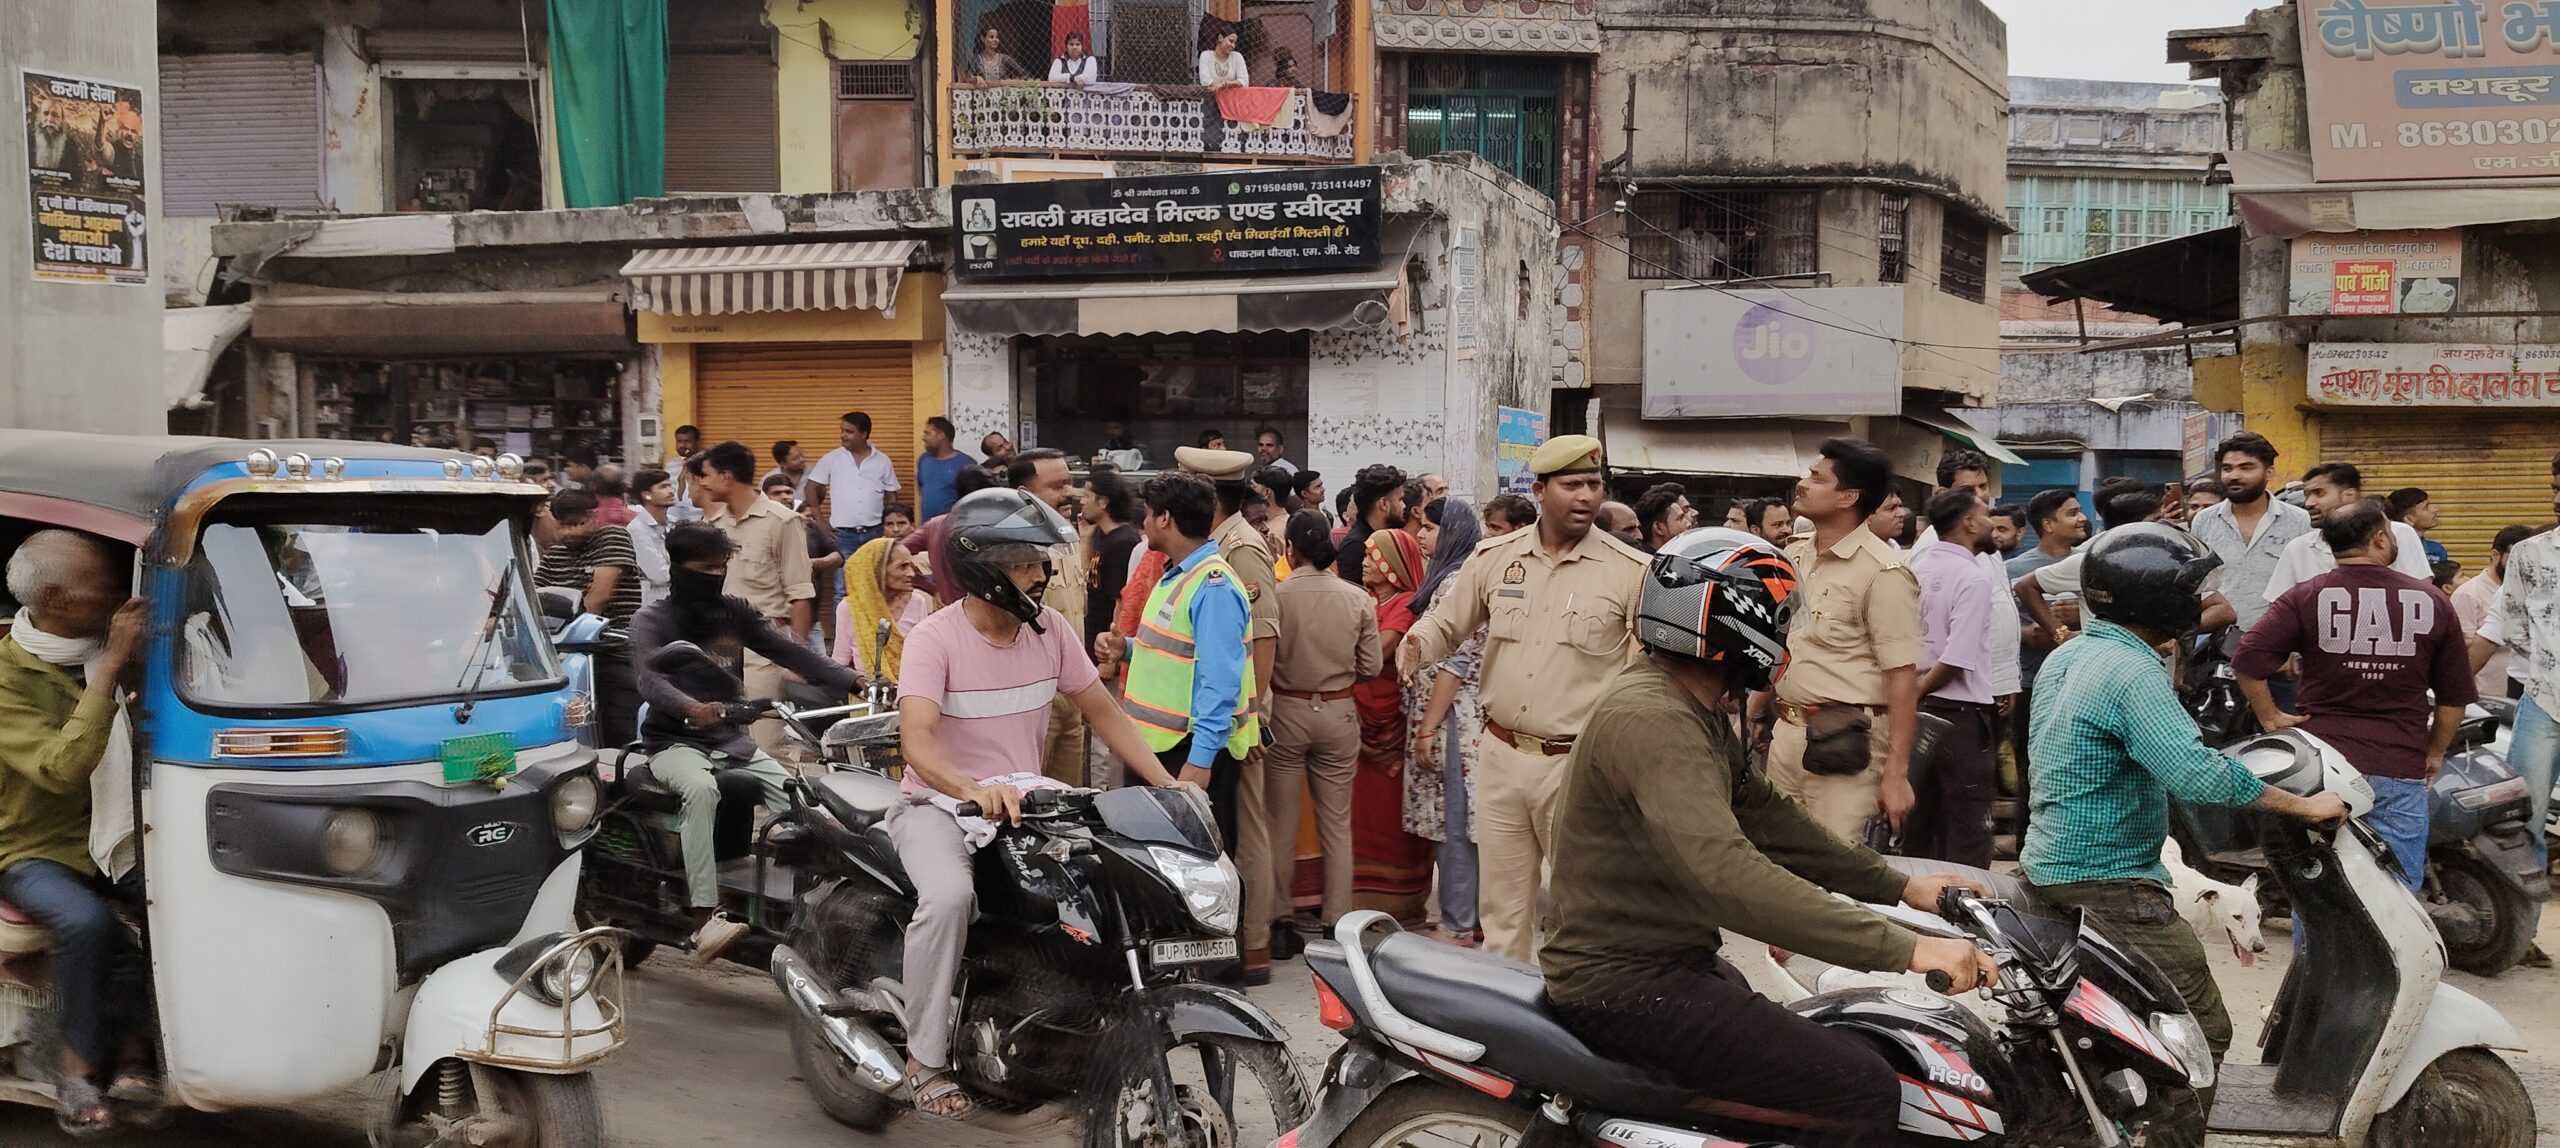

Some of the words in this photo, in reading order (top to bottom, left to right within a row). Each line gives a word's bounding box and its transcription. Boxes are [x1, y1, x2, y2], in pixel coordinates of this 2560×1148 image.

[50, 80, 89, 100] करणी
[91, 83, 116, 103] सेना
[2408, 75, 2555, 102] मशहूर
[2330, 123, 2383, 149] M.
[1311, 179, 1372, 191] 7351414497
[1001, 204, 1065, 229] रावली
[1070, 202, 1150, 228] महादेव
[1155, 200, 1222, 224] मिल्क
[1228, 202, 1277, 221] एण्ड
[1283, 193, 1363, 223] स्वीट्स
[1020, 235, 1047, 248] हमारे
[1049, 234, 1070, 247] यहाँ
[1293, 225, 1331, 239] मिलती
[42, 238, 72, 261] देश
[1343, 244, 1360, 255] रोड
[2336, 274, 2358, 292] पाव
[2361, 270, 2391, 292] भाजी
[1743, 320, 1809, 360] Jio
[2320, 366, 2381, 400] स्पेशल
[2457, 372, 2510, 404] दाल
[2511, 372, 2541, 400] का
[2317, 587, 2434, 656] GAP
[2347, 661, 2369, 670] NEW
[2371, 662, 2399, 671] YORK
[1166, 945, 1179, 960] UP
[1928, 1064, 1985, 1092] Hero
[1609, 1126, 1641, 1140] HF
